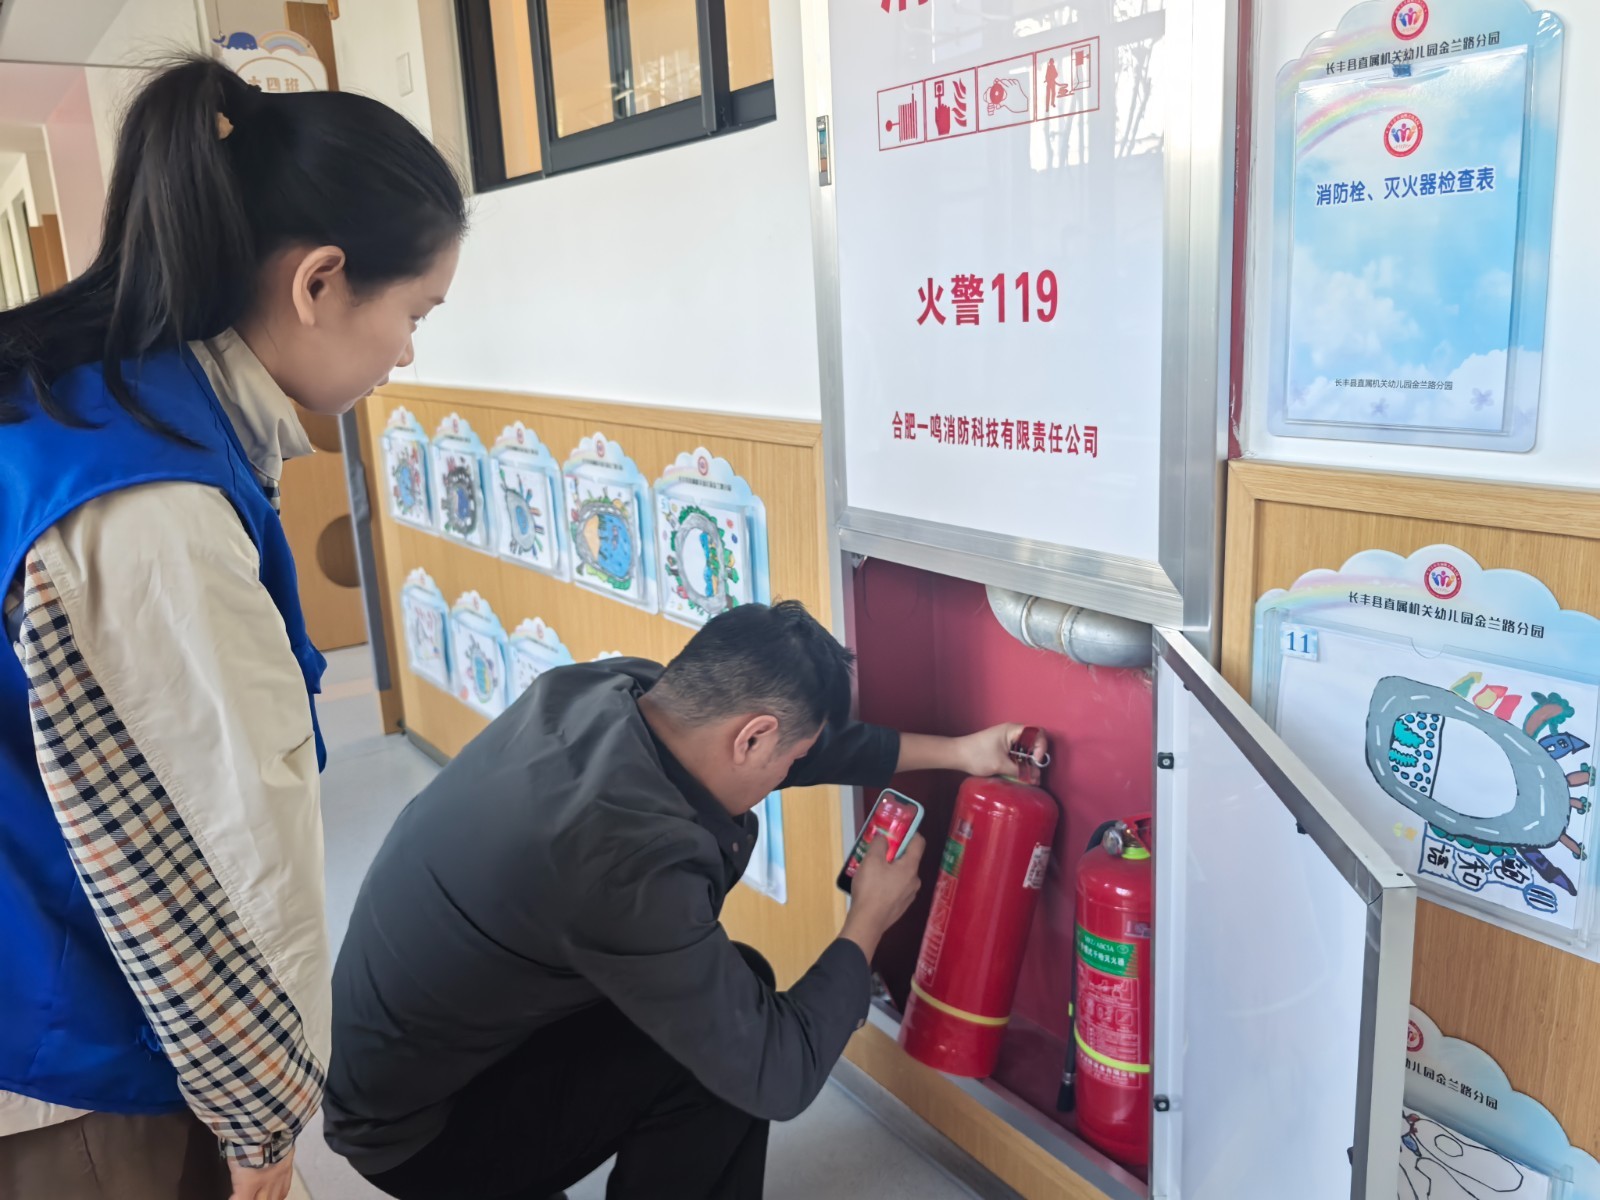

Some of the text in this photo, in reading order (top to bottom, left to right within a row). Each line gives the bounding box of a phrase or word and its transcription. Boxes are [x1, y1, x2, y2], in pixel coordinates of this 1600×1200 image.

[1326, 30, 1501, 75] 长丰县直属机关幼儿园金兰路分园
[1315, 166, 1495, 206] 消防栓、灭火器检查表
[916, 269, 1059, 326] 火警119
[1335, 378, 1454, 391] 长丰县直属机关幼儿园金兰路分园
[891, 410, 1099, 459] 合肥一鸣消防科技有限责任公司
[1348, 591, 1545, 639] 长丰县直属机关幼儿园金兰路分园
[1286, 631, 1311, 654] 11
